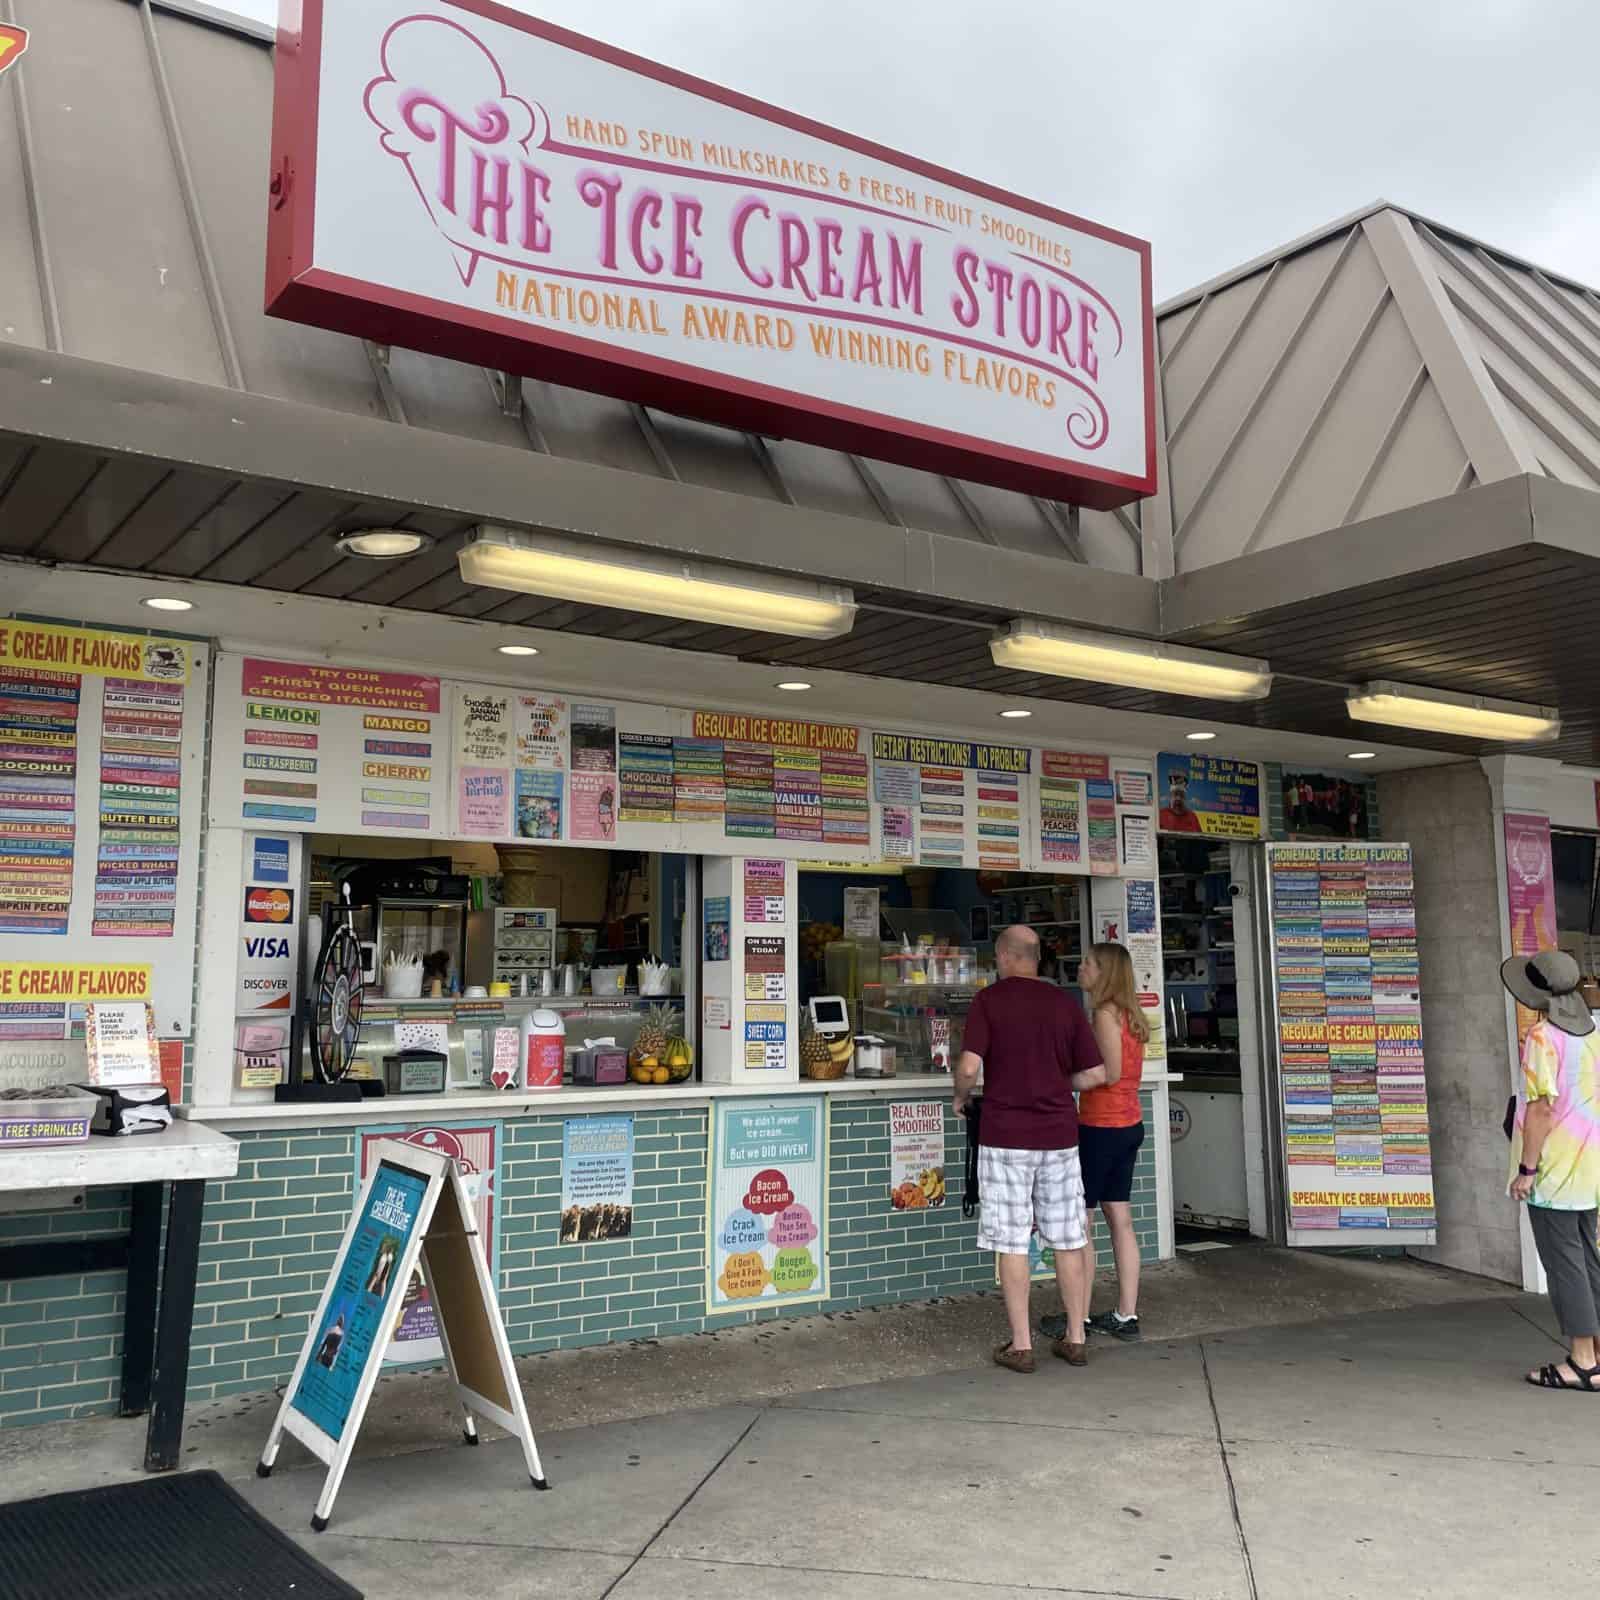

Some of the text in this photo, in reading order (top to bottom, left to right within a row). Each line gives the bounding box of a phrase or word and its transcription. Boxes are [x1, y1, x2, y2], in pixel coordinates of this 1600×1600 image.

[566, 114, 1073, 268] HAND SPUN MILKSHAKES & FRESH FRUIT SMOOTHIES
[399, 90, 1098, 384] THE ICE CREAM STORE
[495, 269, 1057, 409] NATIONAL AWARD WINNING FLAVORS
[12, 630, 68, 664] CREAM
[72, 638, 141, 672] FLAVORS
[0, 667, 38, 681] OBSTER
[310, 668, 381, 682] TRY OUR
[262, 675, 425, 699] THIRST QUENCHING
[335, 695, 399, 709] ITALIAN
[403, 701, 430, 712] ICE
[249, 704, 318, 724] LEMON
[365, 716, 429, 732] MANGO
[695, 713, 856, 750] REGULAR ICE CREAM FLAVORS
[874, 735, 908, 761] DIETARY
[977, 746, 989, 769] NO
[246, 755, 315, 772] BLUE RASPBERRY
[366, 763, 428, 781] CHERRY
[775, 793, 820, 805] VANILLA
[1275, 848, 1408, 862] HOMEMADE ICE CREAM FLAVORS
[243, 936, 290, 958] VISA
[19, 970, 73, 994] CREAM
[78, 971, 146, 994] FLAVORS
[243, 979, 288, 990] DISCOVER
[748, 1024, 767, 1039] SWEET
[1282, 1024, 1418, 1041] REGULAR ICE CREAM FLAVORS
[891, 1103, 942, 1119] REAL FRUIT
[6, 1122, 84, 1138] FREE SPRINKLES
[892, 1118, 942, 1134] SMOOTHIES
[730, 1148, 745, 1160] But
[761, 1144, 777, 1158] DID
[779, 1143, 809, 1157] INVENT
[756, 1180, 781, 1191] Bacon
[748, 1192, 789, 1205] Ice Cream
[1292, 1191, 1431, 1206] SPECIALTY ICE CREAM FLAVORS
[732, 1219, 756, 1231] Crack
[779, 1222, 794, 1231] Than
[723, 1232, 765, 1245] Ice Cream
[776, 1232, 809, 1242] Ice Cream
[774, 1269, 814, 1281] Ice Cream
[728, 1279, 761, 1290] Ice Cream
